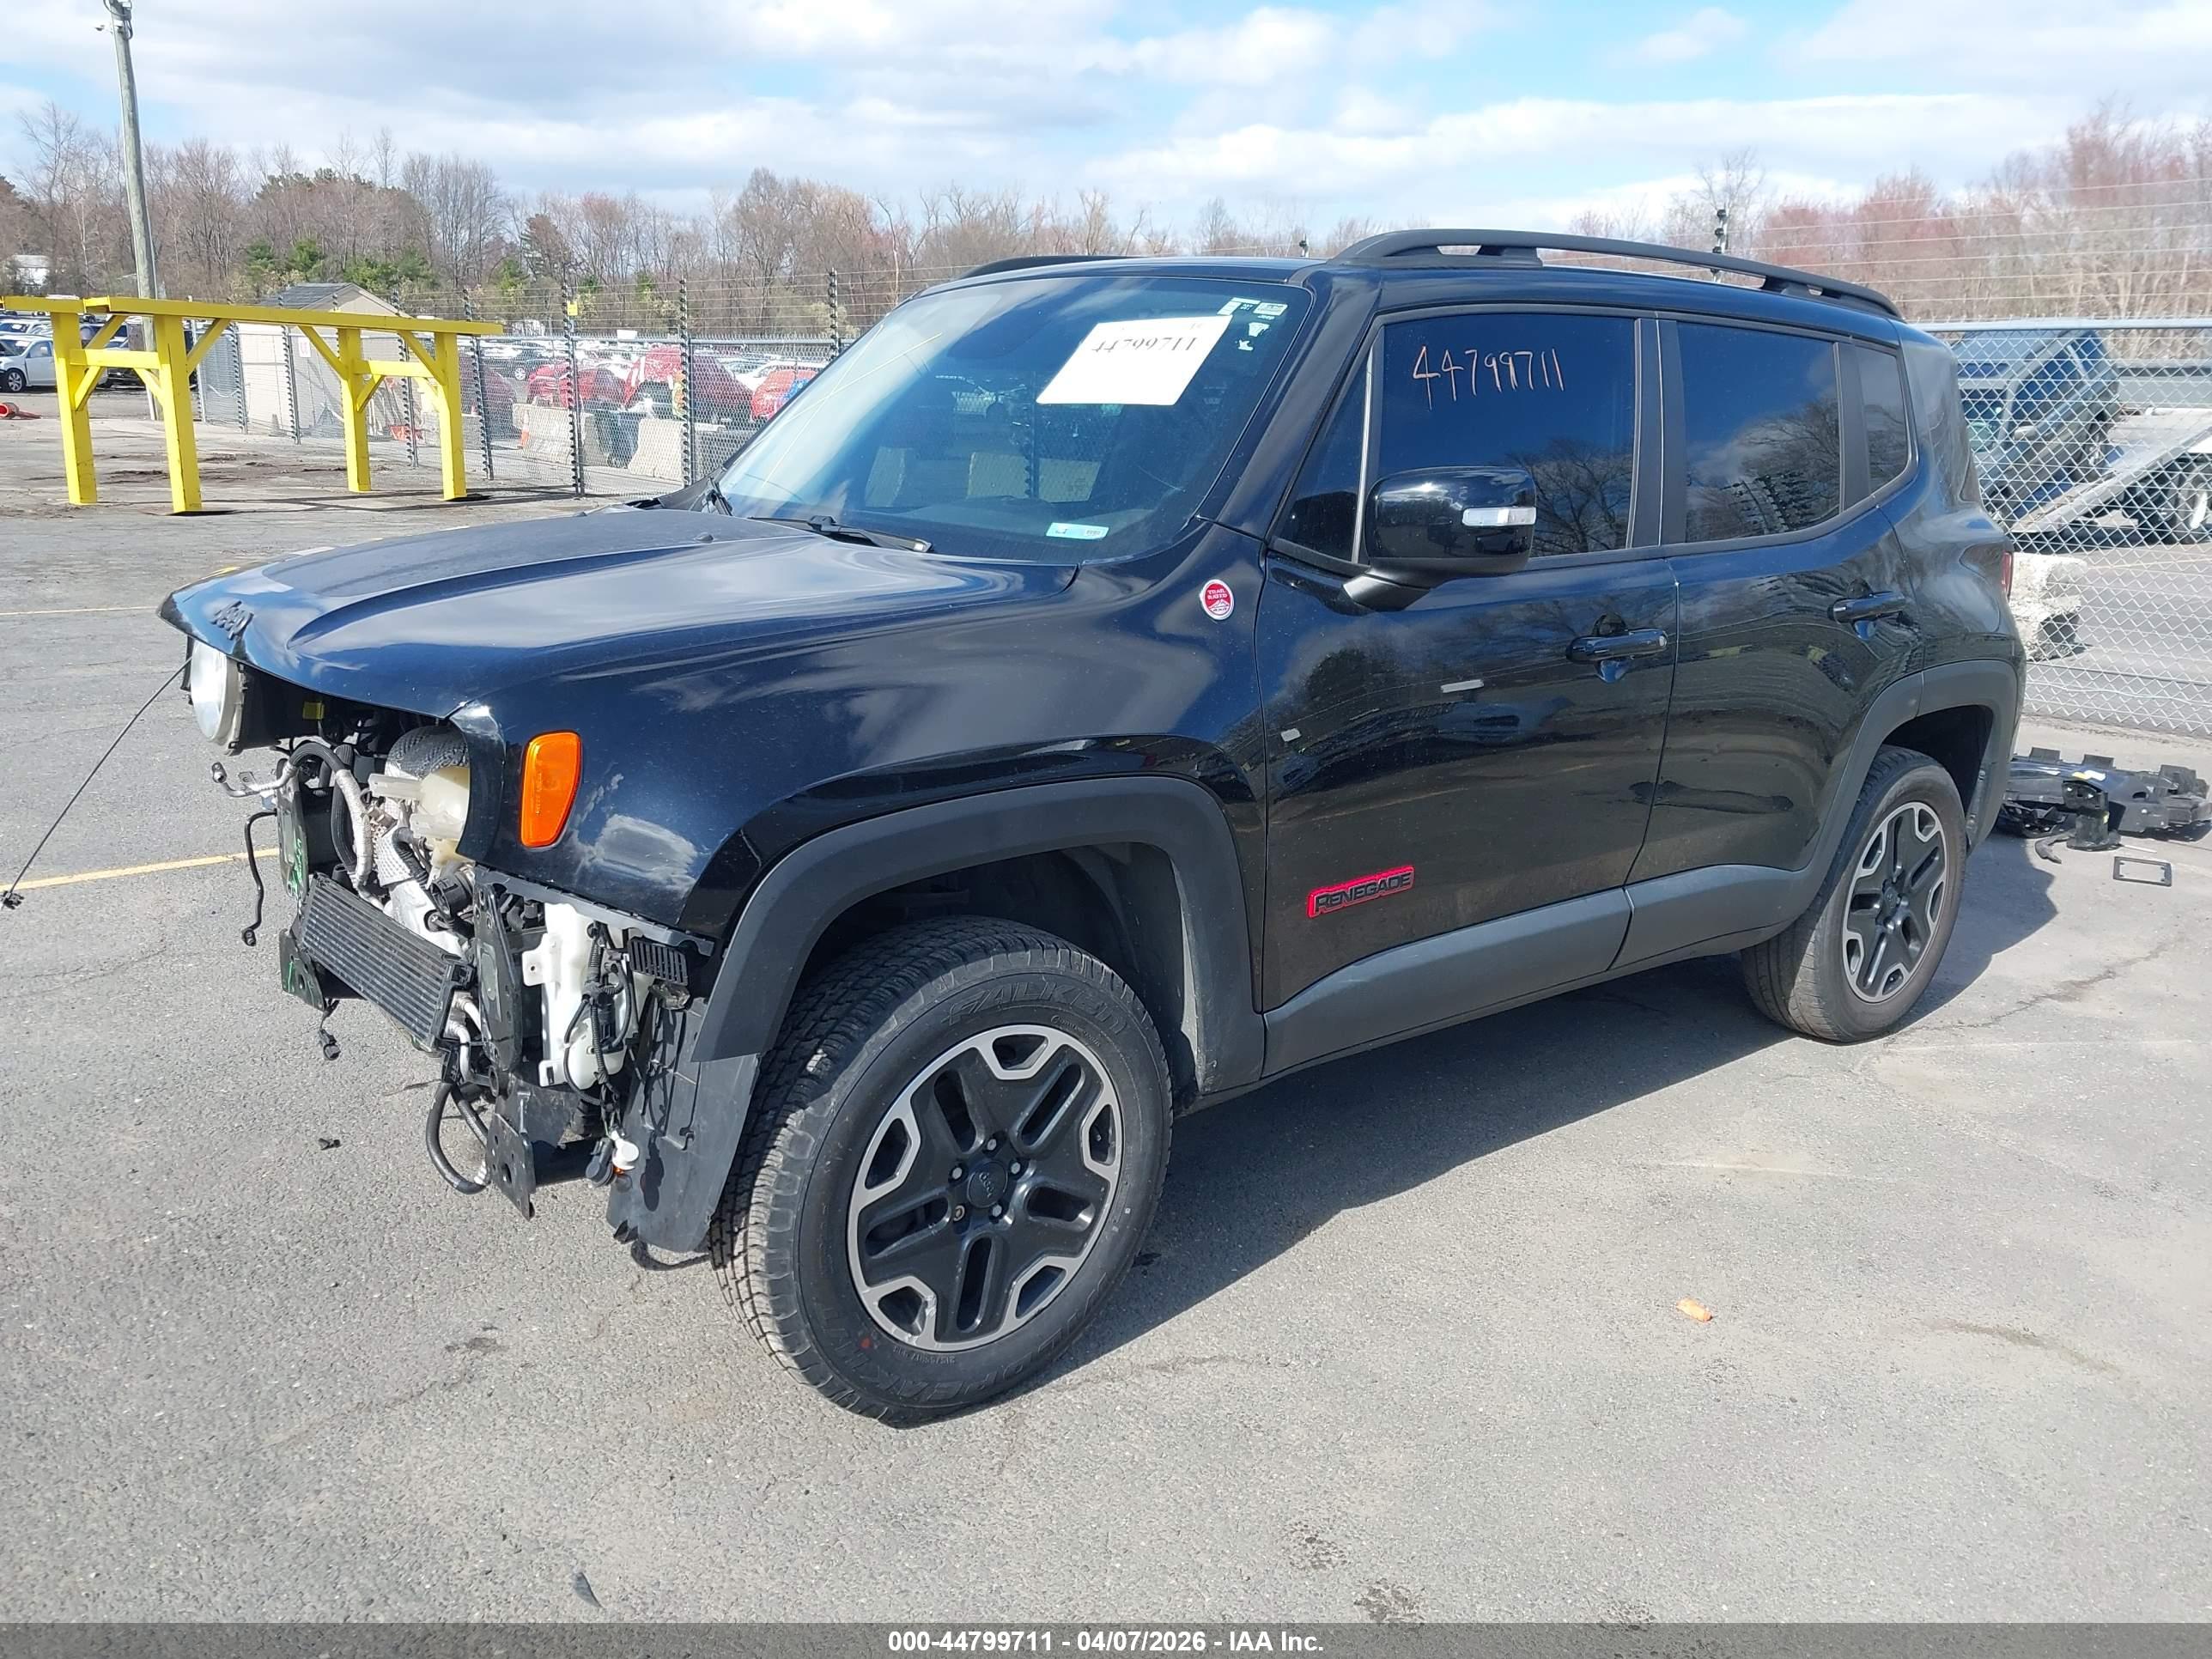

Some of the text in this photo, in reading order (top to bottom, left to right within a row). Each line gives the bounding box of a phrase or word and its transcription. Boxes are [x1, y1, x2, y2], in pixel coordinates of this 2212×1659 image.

[1091, 336, 1197, 353] 44799711
[1413, 345, 1565, 411] 44799711
[1314, 870, 1413, 915] RENEGADE
